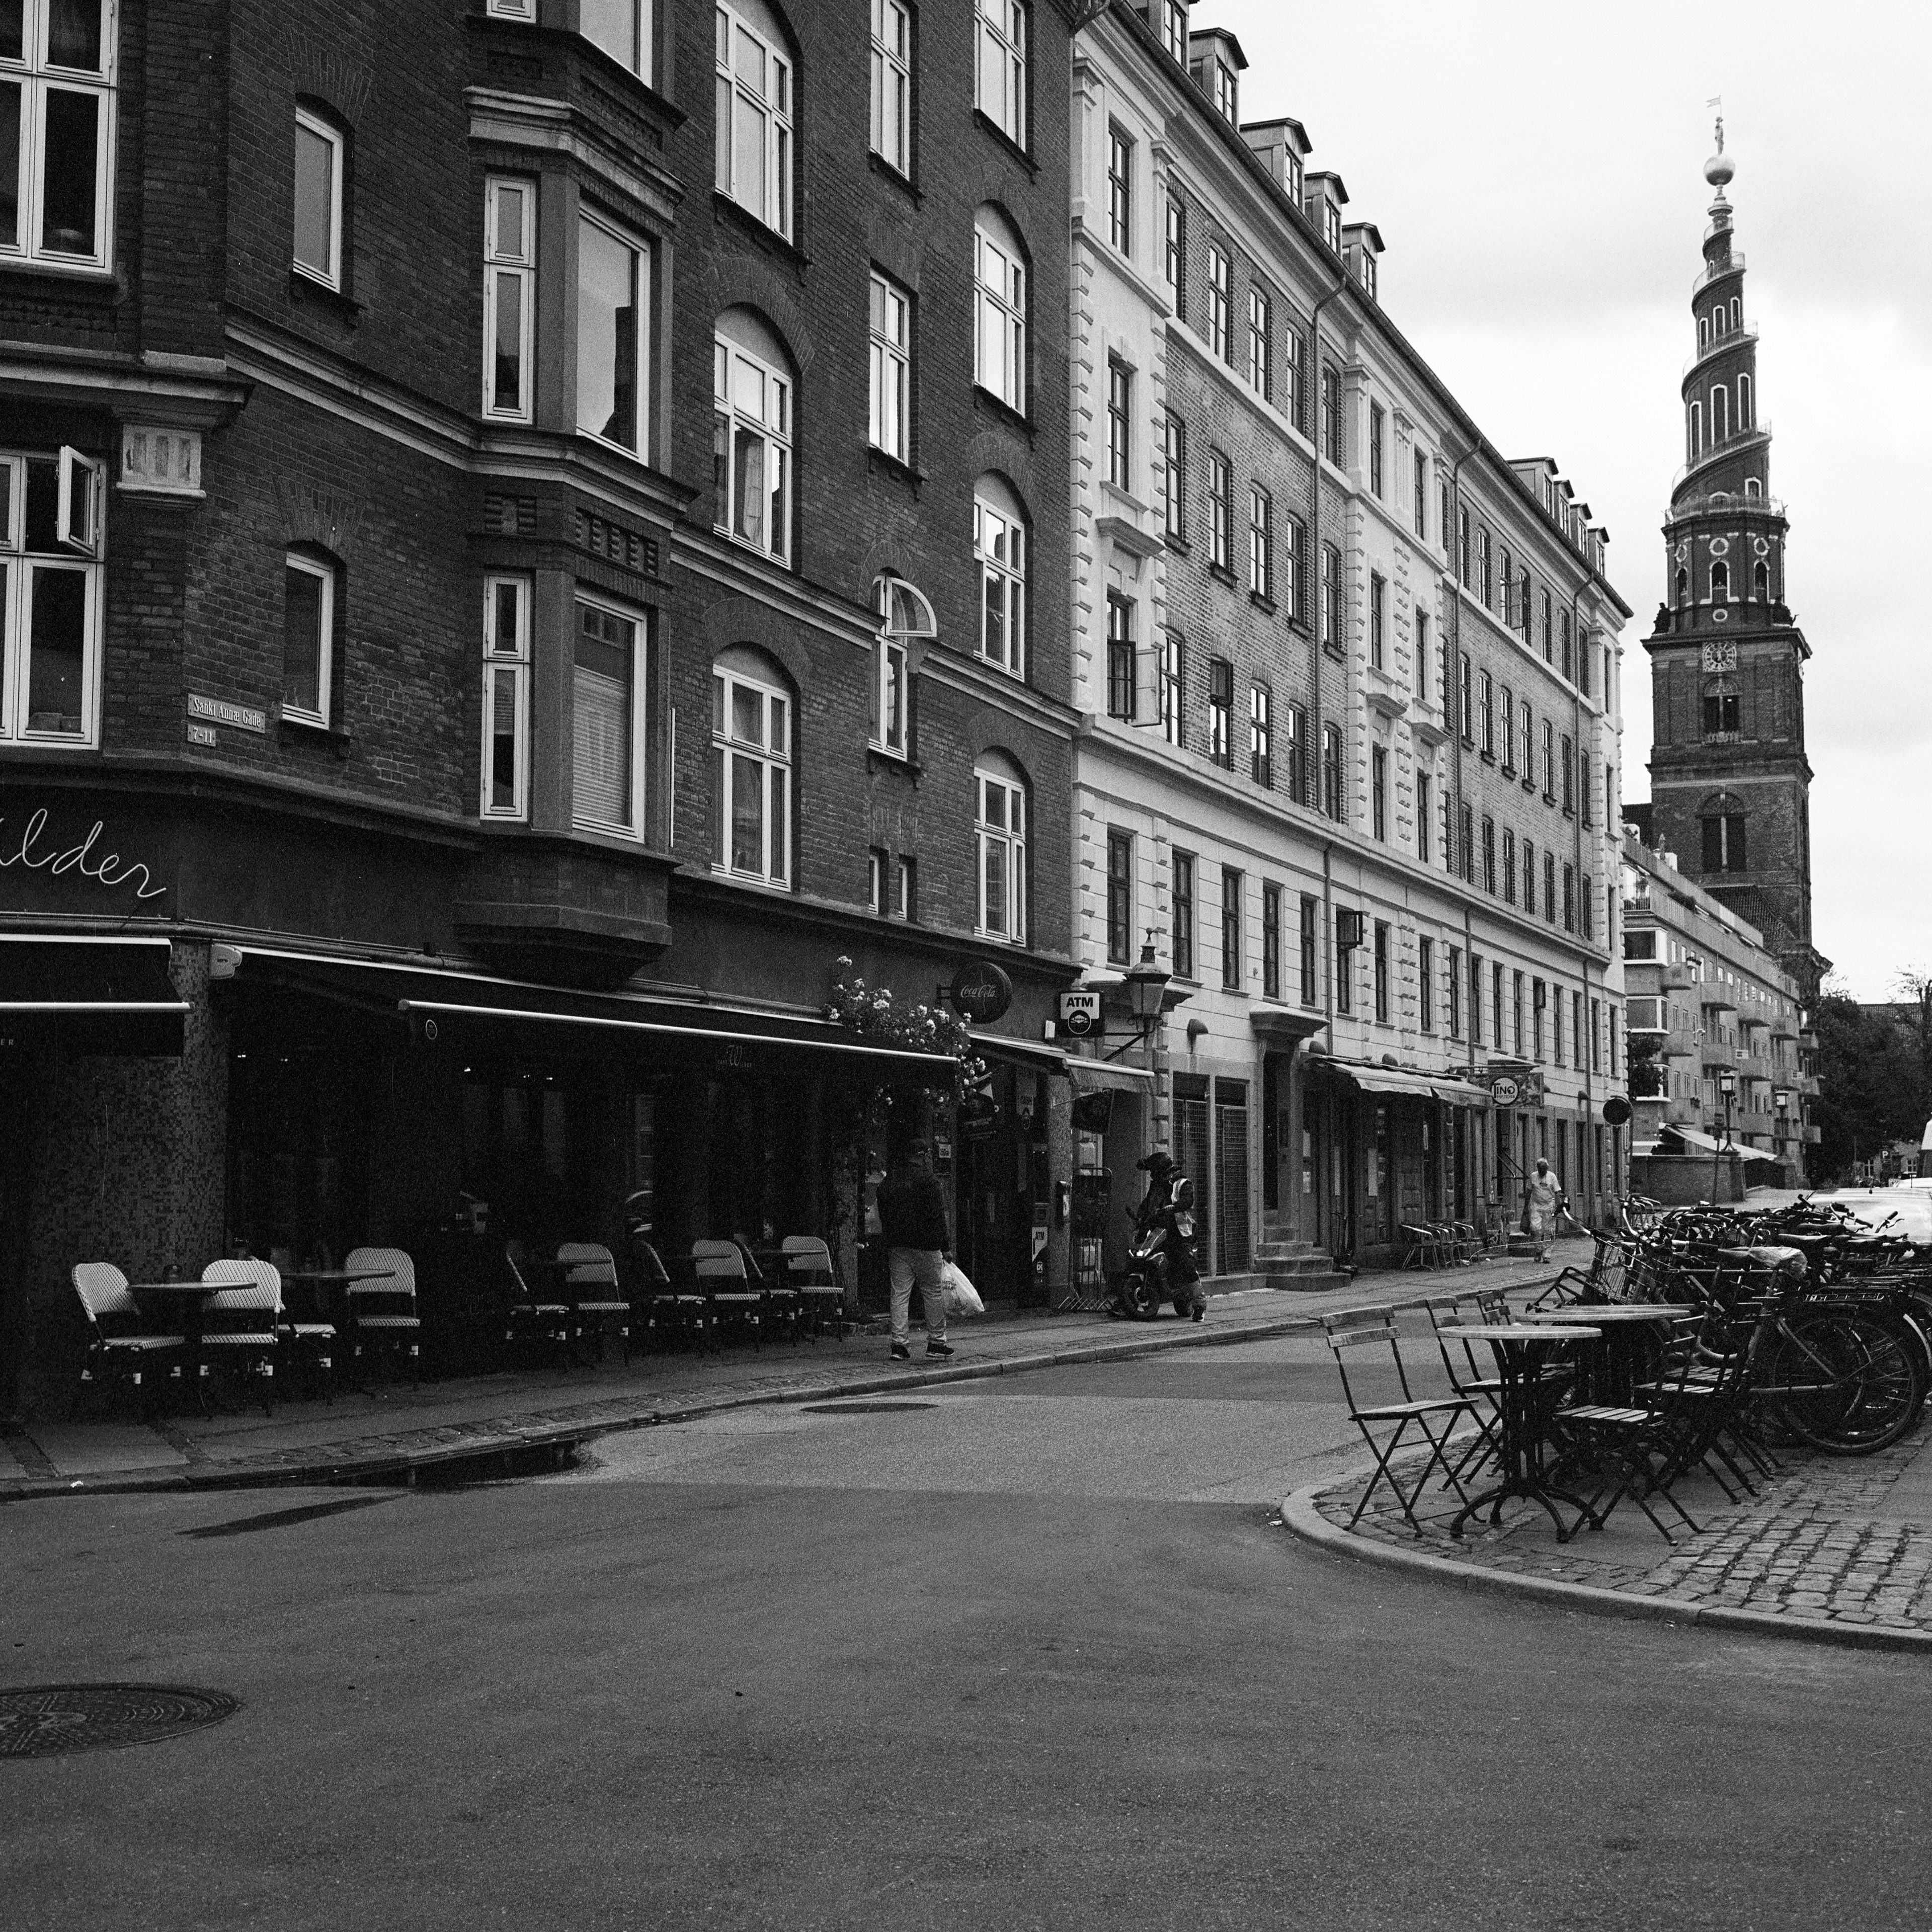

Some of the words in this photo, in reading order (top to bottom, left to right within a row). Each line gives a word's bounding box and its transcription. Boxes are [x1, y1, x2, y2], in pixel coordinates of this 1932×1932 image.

[194, 697, 216, 716] Sankt
[218, 704, 239, 722] Annæ
[243, 709, 261, 727] Gade
[194, 727, 212, 744] 7-11
[1066, 997, 1093, 1007] ATM
[1492, 1083, 1515, 1099] TINO
[1882, 1150, 1889, 1159] P
